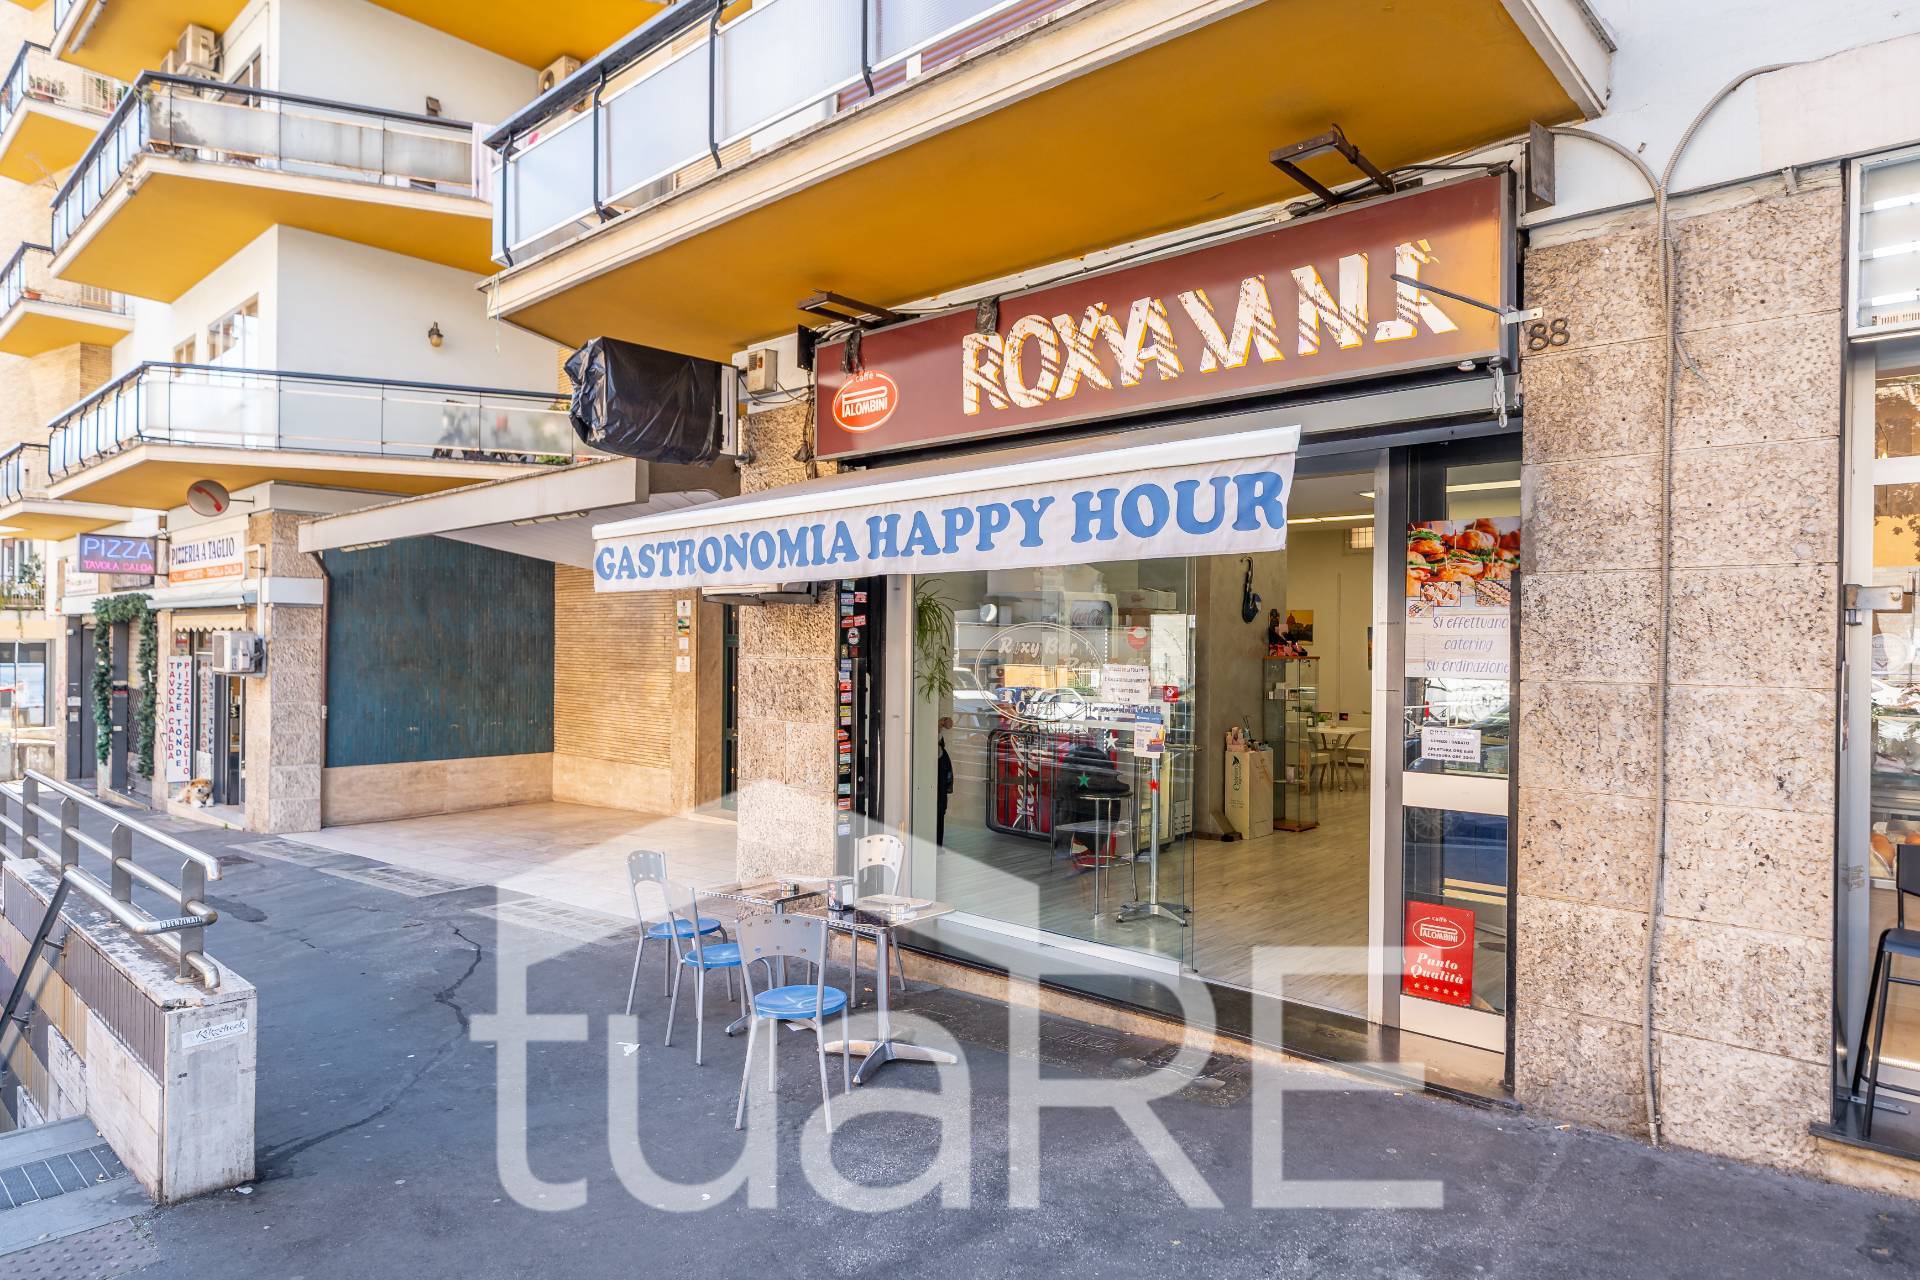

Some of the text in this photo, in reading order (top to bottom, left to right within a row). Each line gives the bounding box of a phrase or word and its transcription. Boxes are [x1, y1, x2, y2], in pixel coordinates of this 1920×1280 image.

[1529, 317, 1571, 351] 88
[841, 386, 888, 418] PALOMBINI
[595, 471, 1286, 581] GASTRONOMIA HAPPY HOUR
[171, 544, 199, 566] PIZZERIA
[208, 537, 235, 560] TAGLIO
[84, 560, 154, 573] TAVOLA CALDA
[1444, 637, 1494, 653] catering
[1420, 923, 1458, 943] PALOMBINI
[1417, 952, 1458, 970] Punto
[1410, 963, 1464, 985] Qualità
